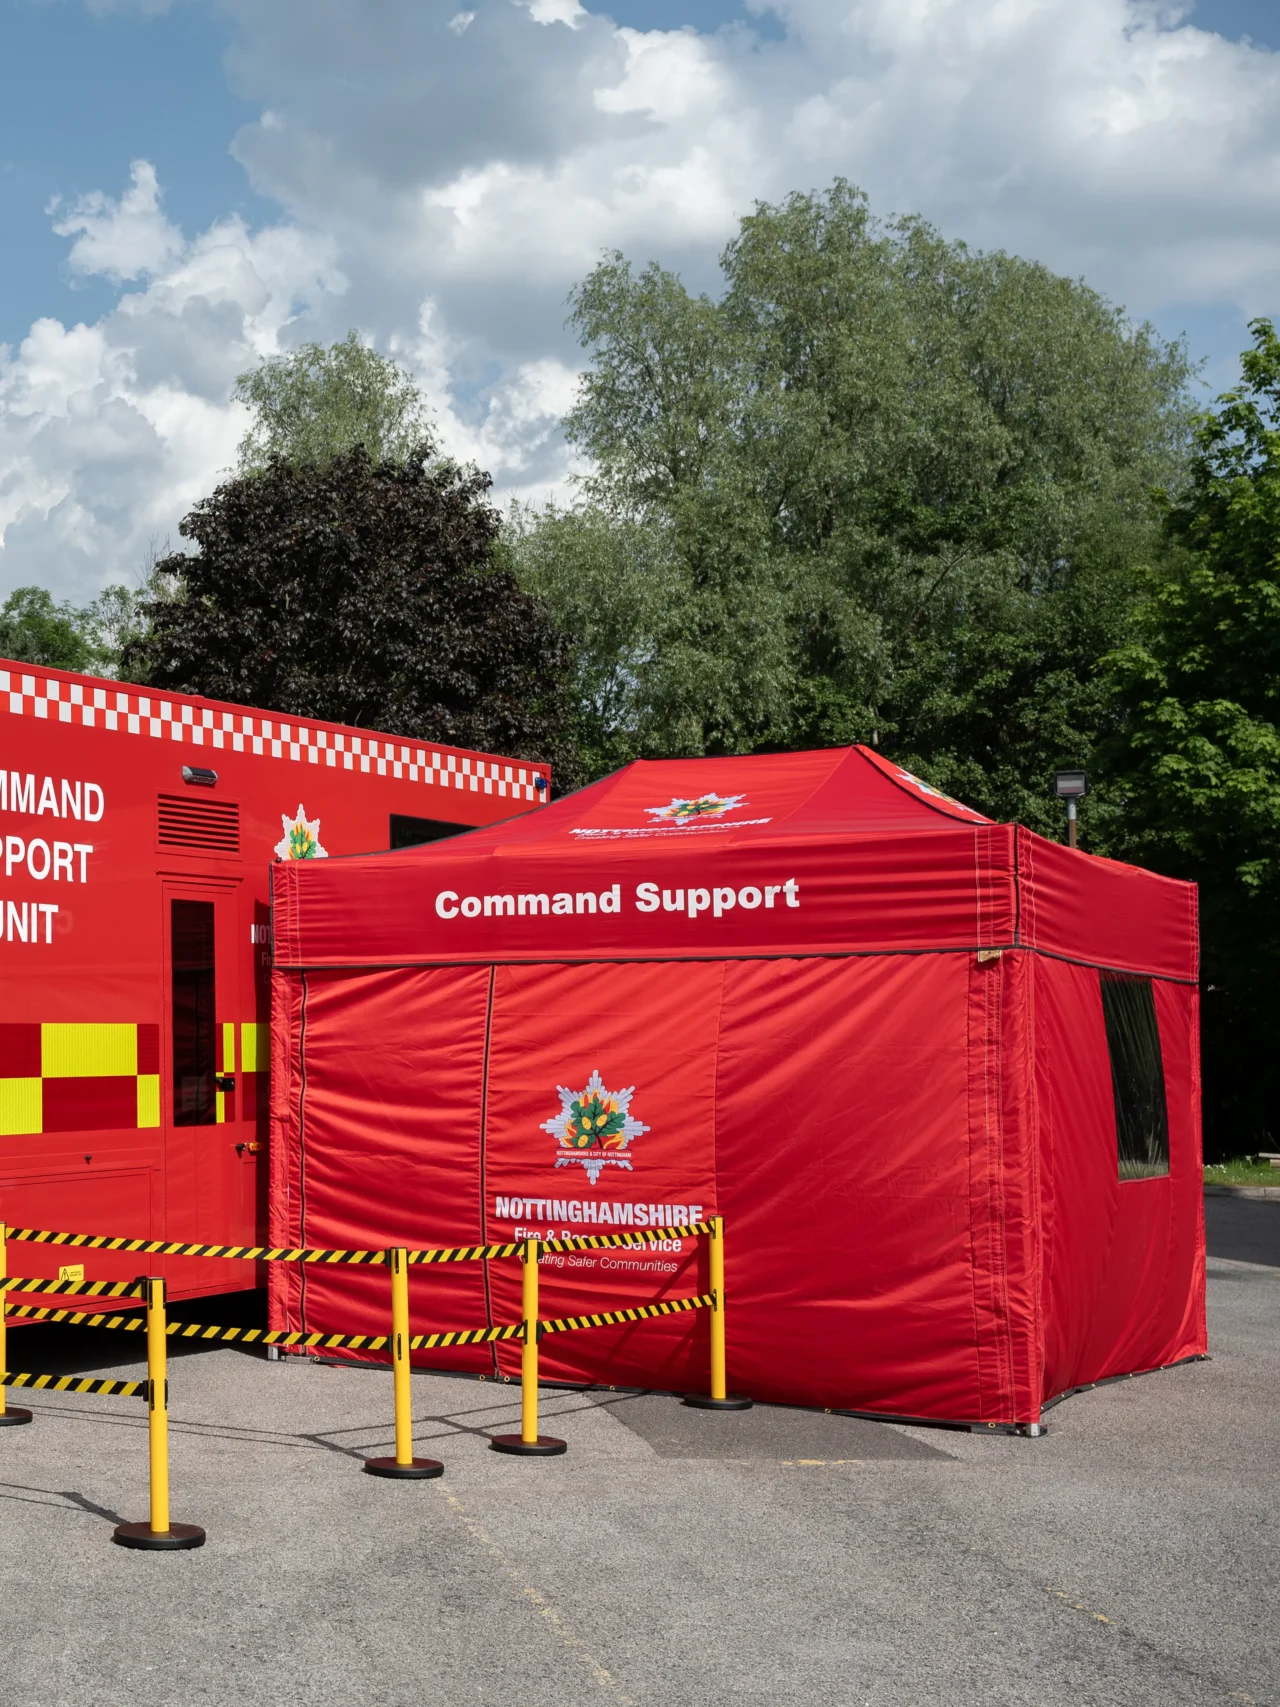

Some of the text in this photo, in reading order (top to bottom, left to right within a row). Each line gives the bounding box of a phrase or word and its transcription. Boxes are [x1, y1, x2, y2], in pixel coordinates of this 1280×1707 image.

[435, 877, 801, 919] Command Support
[495, 1196, 703, 1227] NOTTINGHAMSHIRE
[568, 1254, 597, 1268] Safer
[600, 1256, 678, 1273] Communities
